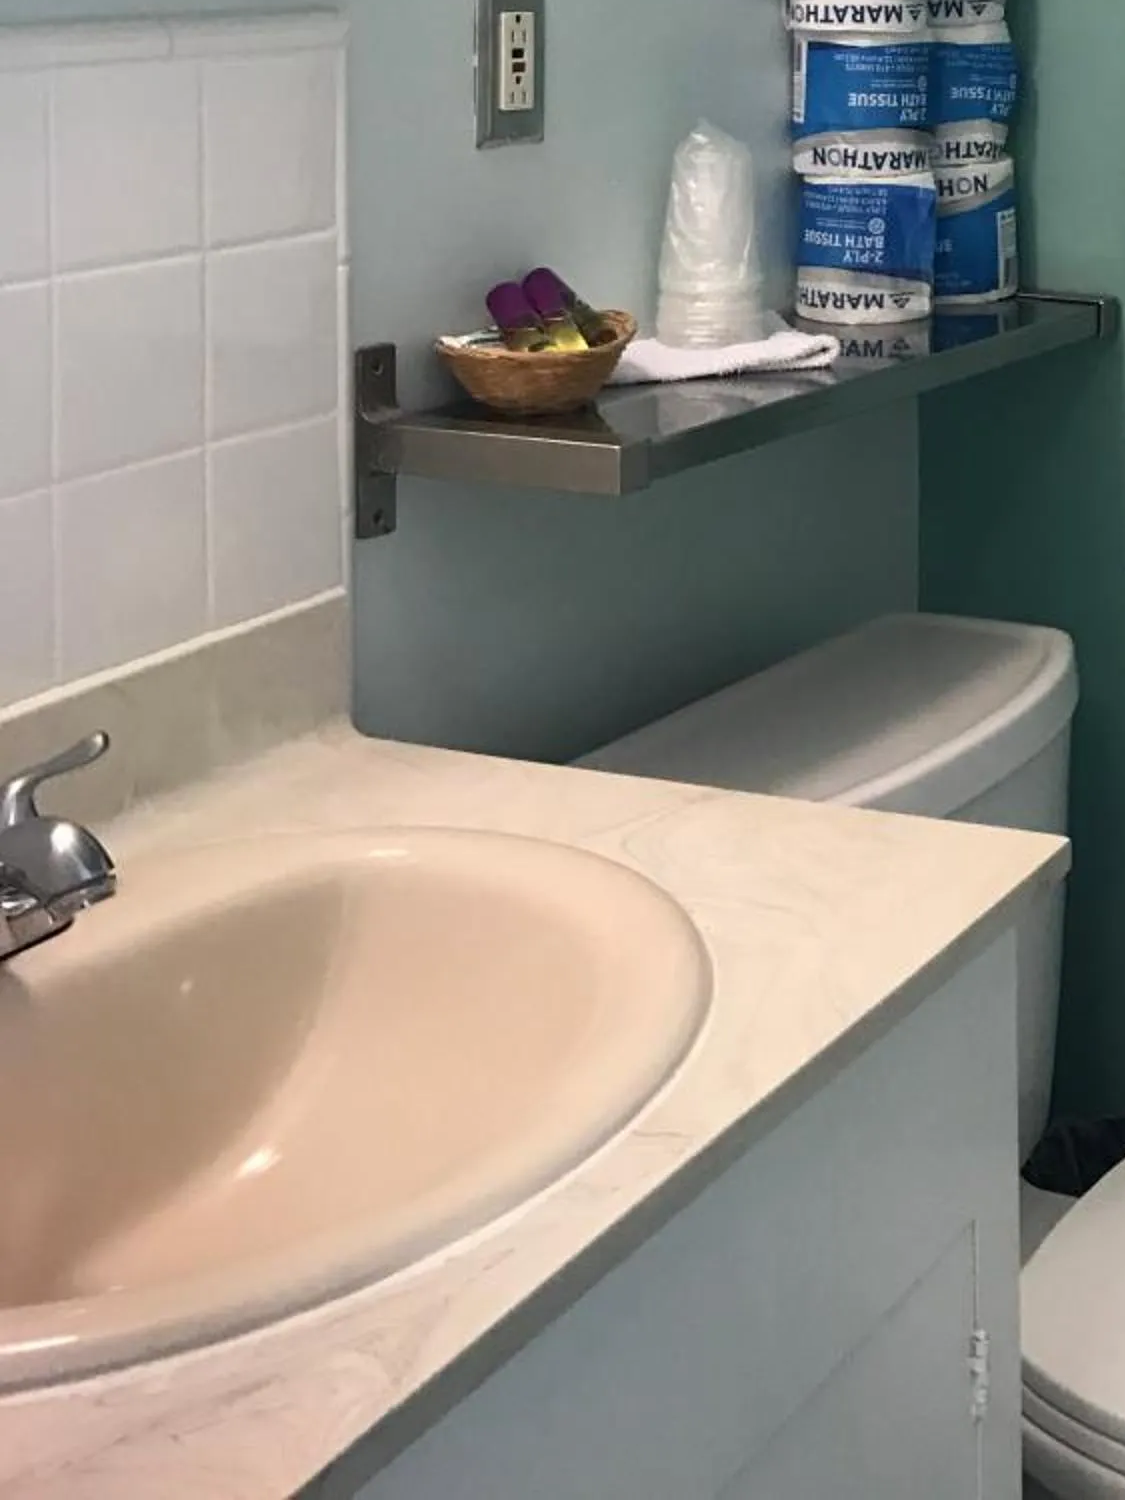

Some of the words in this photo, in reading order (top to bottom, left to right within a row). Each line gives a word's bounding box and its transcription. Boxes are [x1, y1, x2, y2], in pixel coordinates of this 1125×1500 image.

[848, 92, 898, 107] TISSUE
[813, 147, 929, 170] MARATHON
[845, 235, 885, 248] BATH
[843, 250, 885, 263] 2-PLY
[799, 286, 884, 309] MARATH
